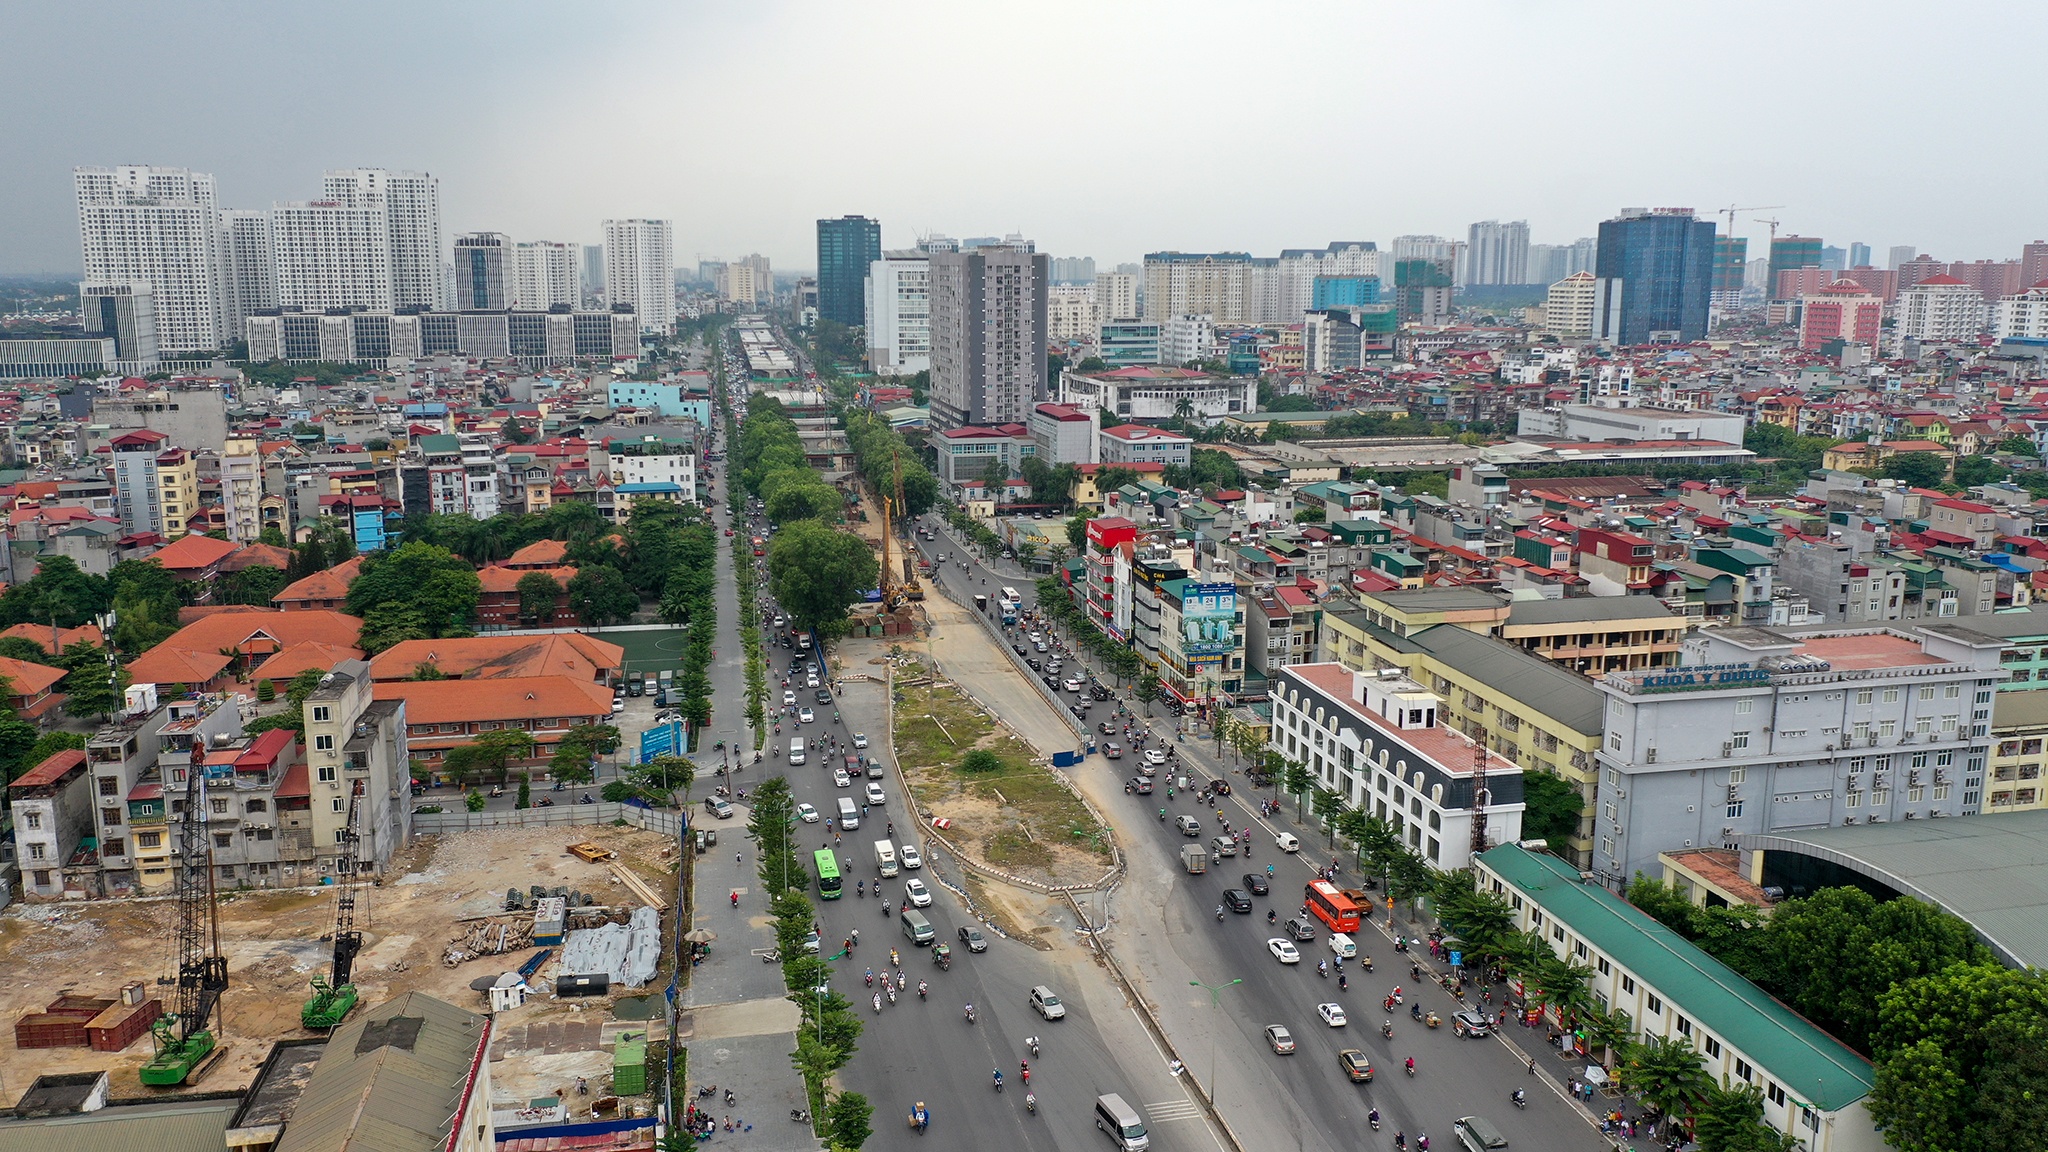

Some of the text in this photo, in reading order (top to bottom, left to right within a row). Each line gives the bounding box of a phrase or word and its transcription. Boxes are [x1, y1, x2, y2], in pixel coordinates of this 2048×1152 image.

[1027, 535, 1047, 545] RICCO
[1642, 674, 1696, 688] KHOA
[1702, 673, 1714, 685] Y
